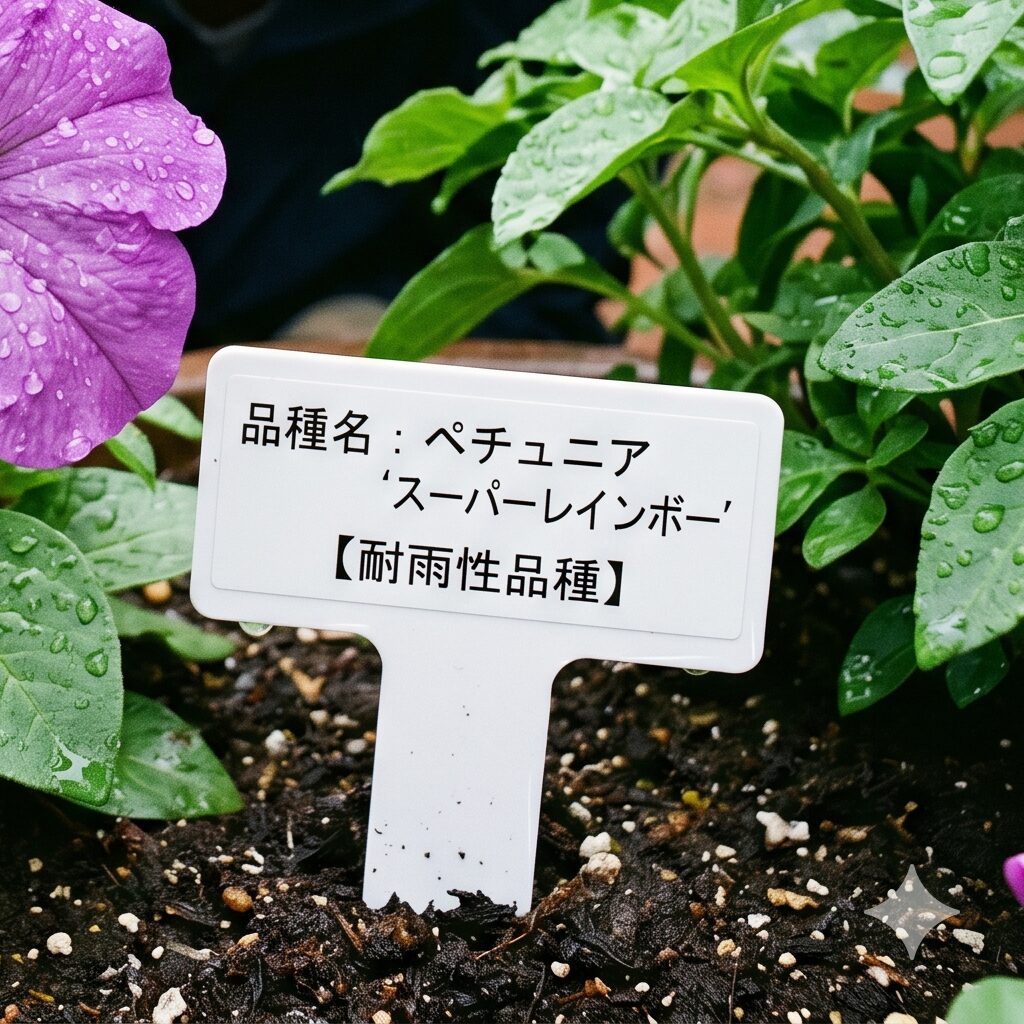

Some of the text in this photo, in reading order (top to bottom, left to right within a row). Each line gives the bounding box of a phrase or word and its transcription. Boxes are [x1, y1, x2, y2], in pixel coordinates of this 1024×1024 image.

[335, 534, 624, 607] 【耐雨性品種】
